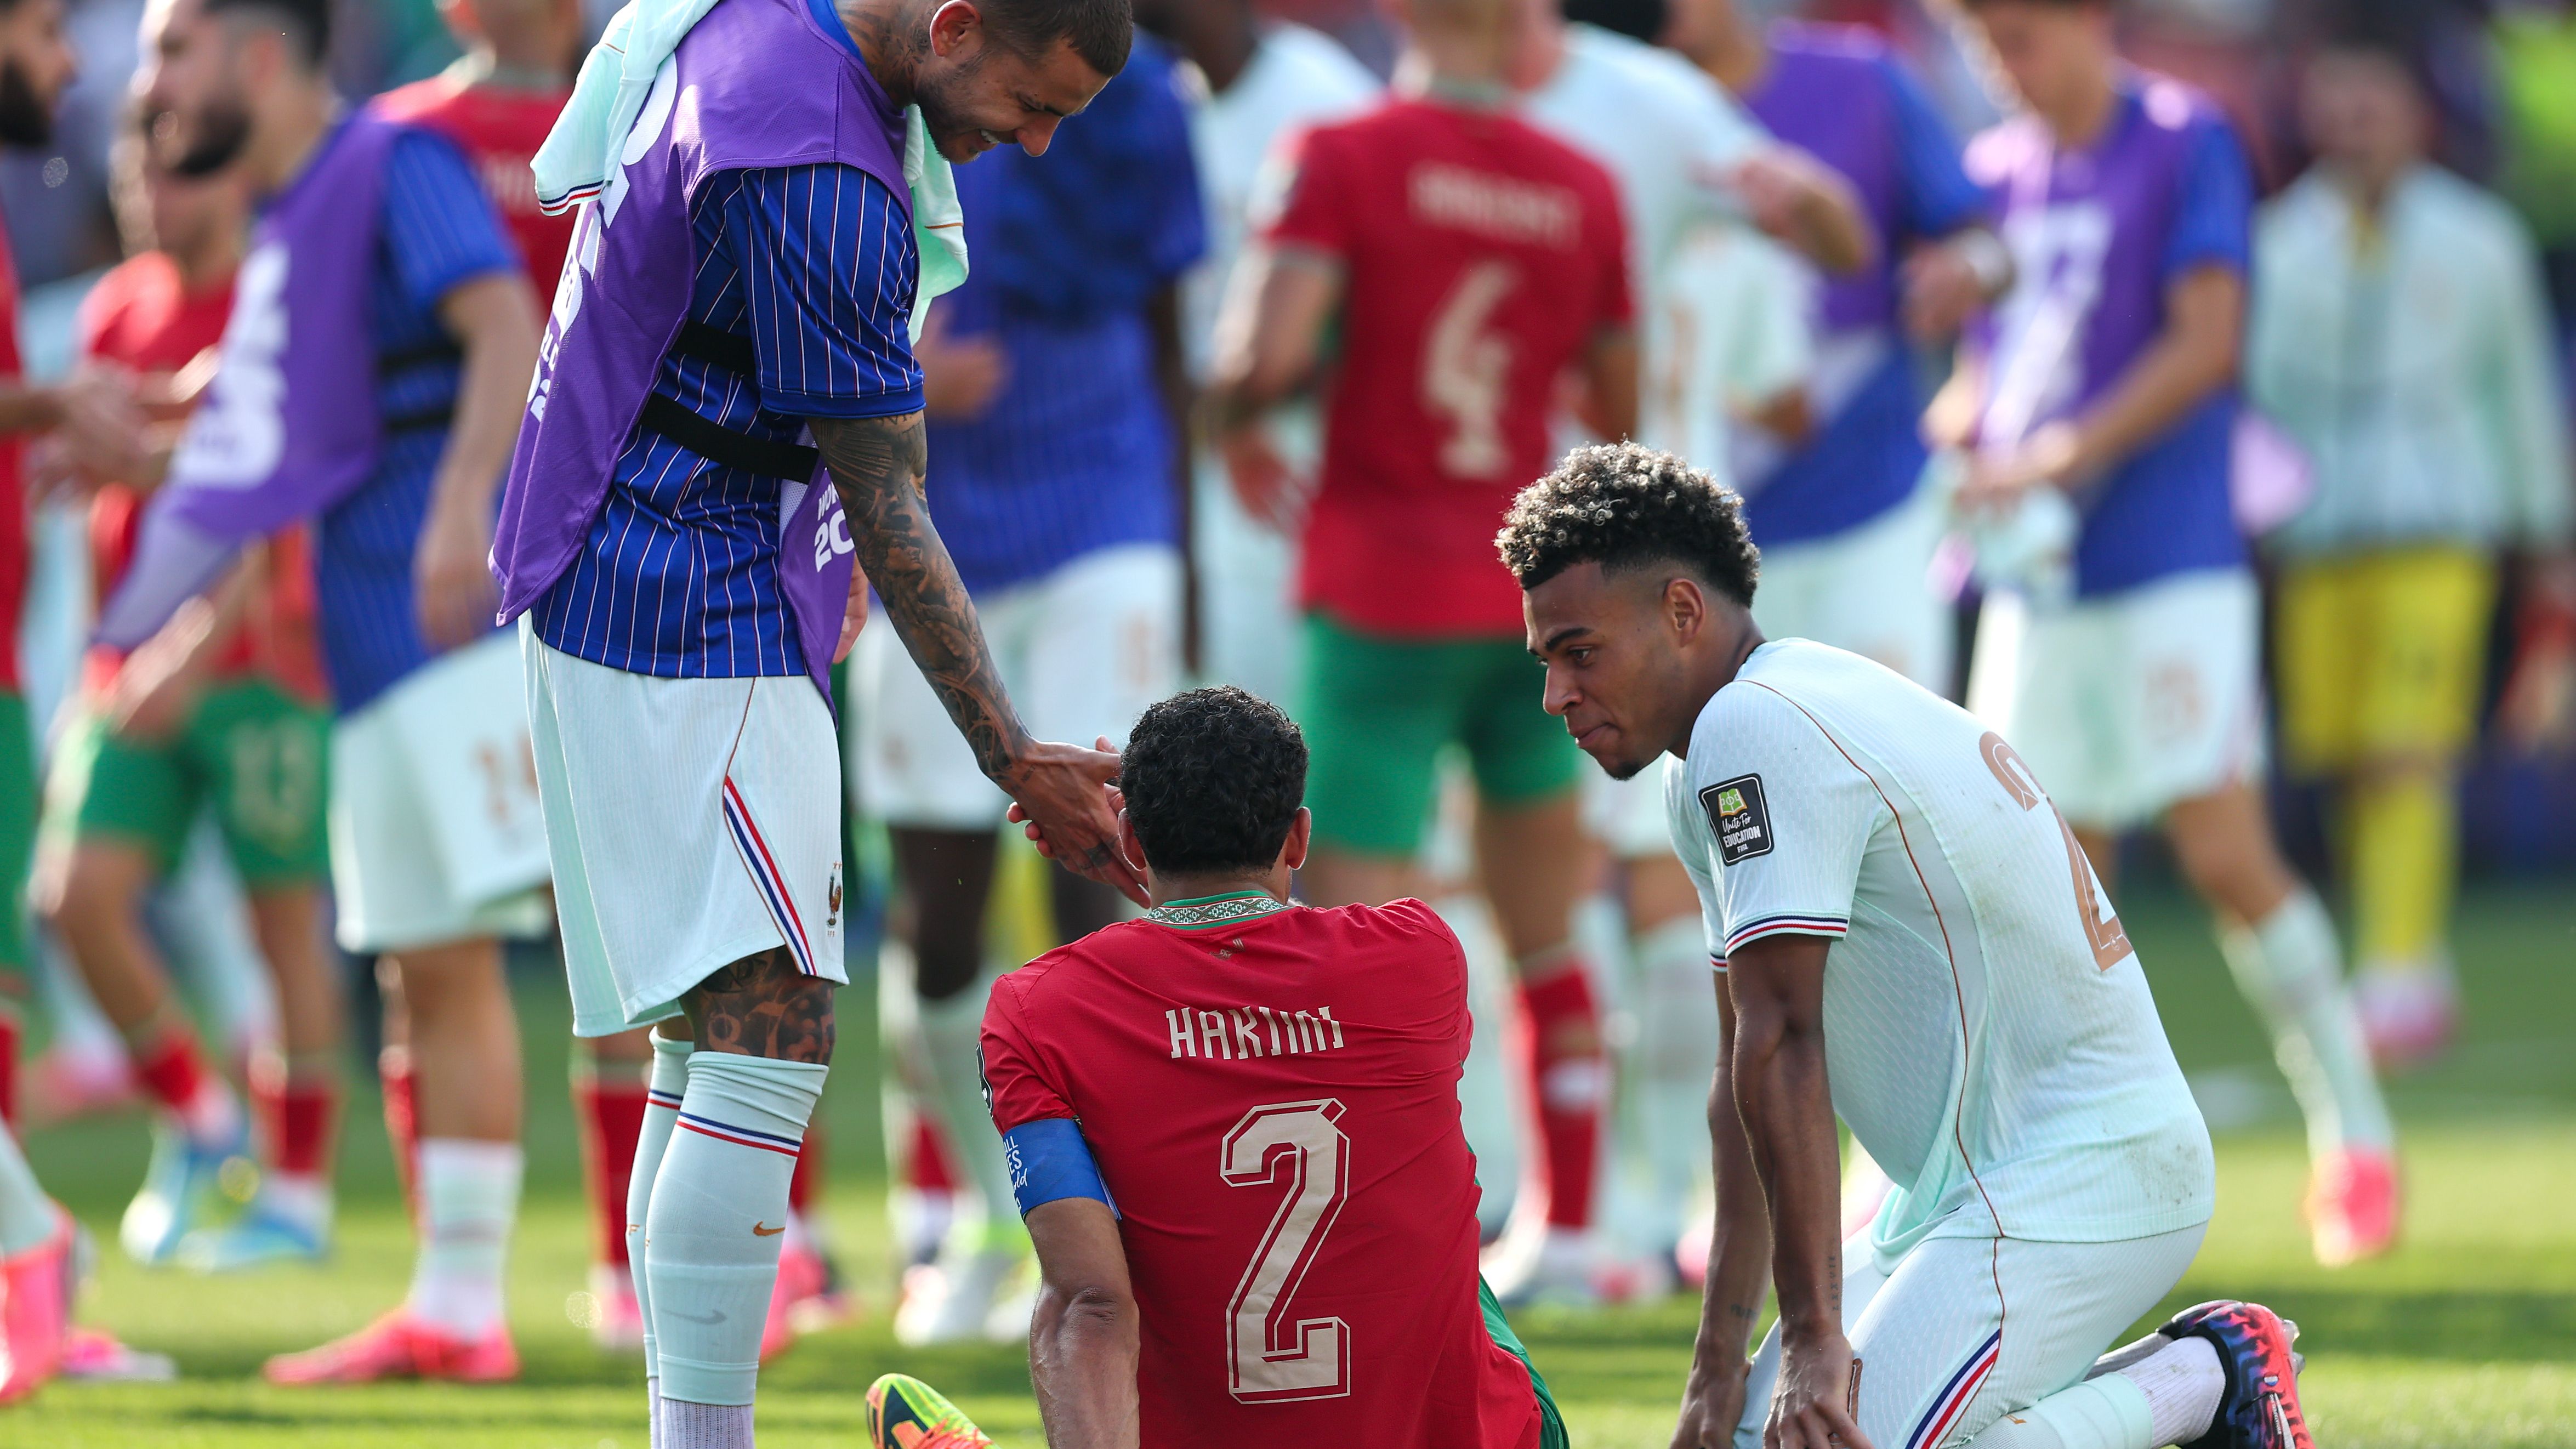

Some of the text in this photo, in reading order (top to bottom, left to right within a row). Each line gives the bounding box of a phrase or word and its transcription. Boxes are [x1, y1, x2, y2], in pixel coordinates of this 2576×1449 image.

[1423, 260, 1519, 480] 4
[1722, 812, 1752, 833] Unite For
[1723, 825, 1761, 848] EDUCATION
[1737, 843, 1749, 853] FIFA
[1220, 1098, 1350, 1405] 2
